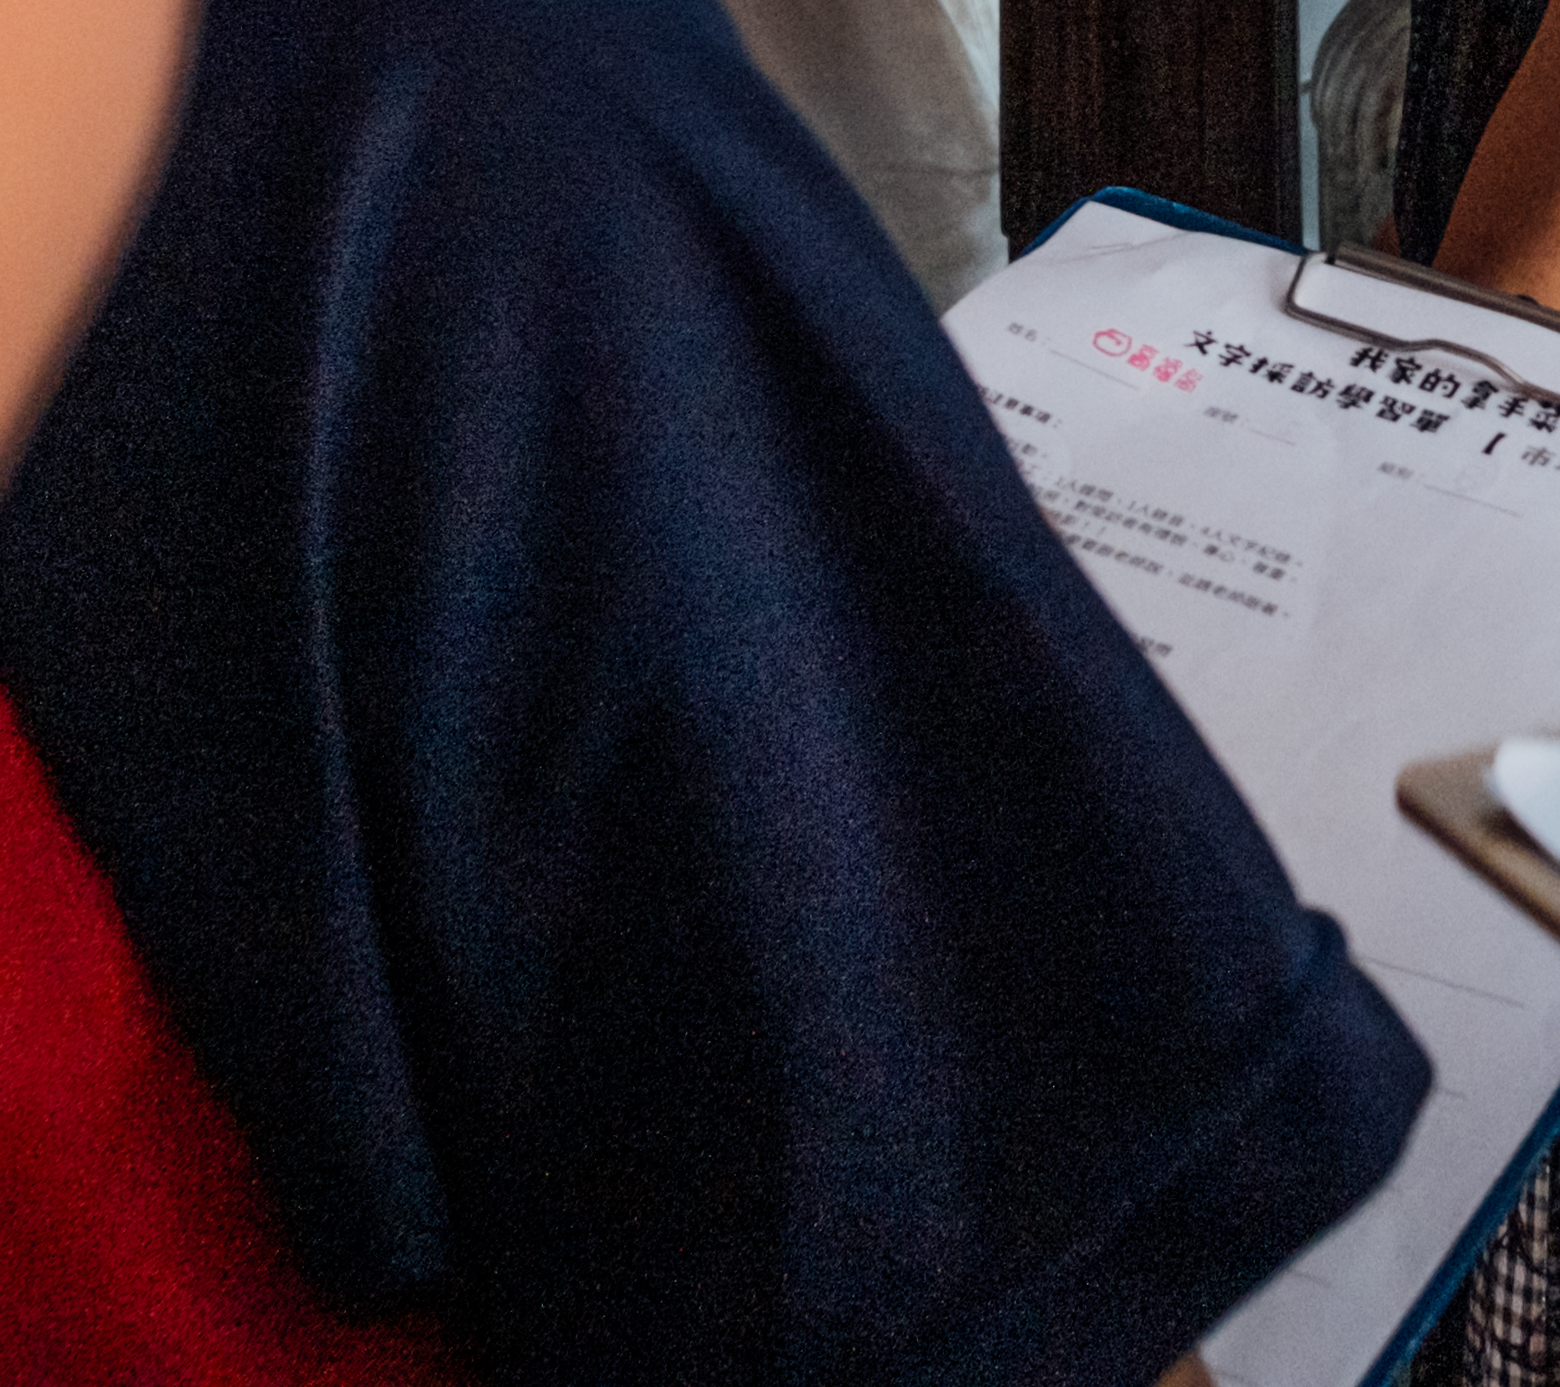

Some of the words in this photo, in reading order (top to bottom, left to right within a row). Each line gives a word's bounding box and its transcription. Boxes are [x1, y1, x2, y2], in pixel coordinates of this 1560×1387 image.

[1183, 329, 1452, 435] 文字採訪學習單
